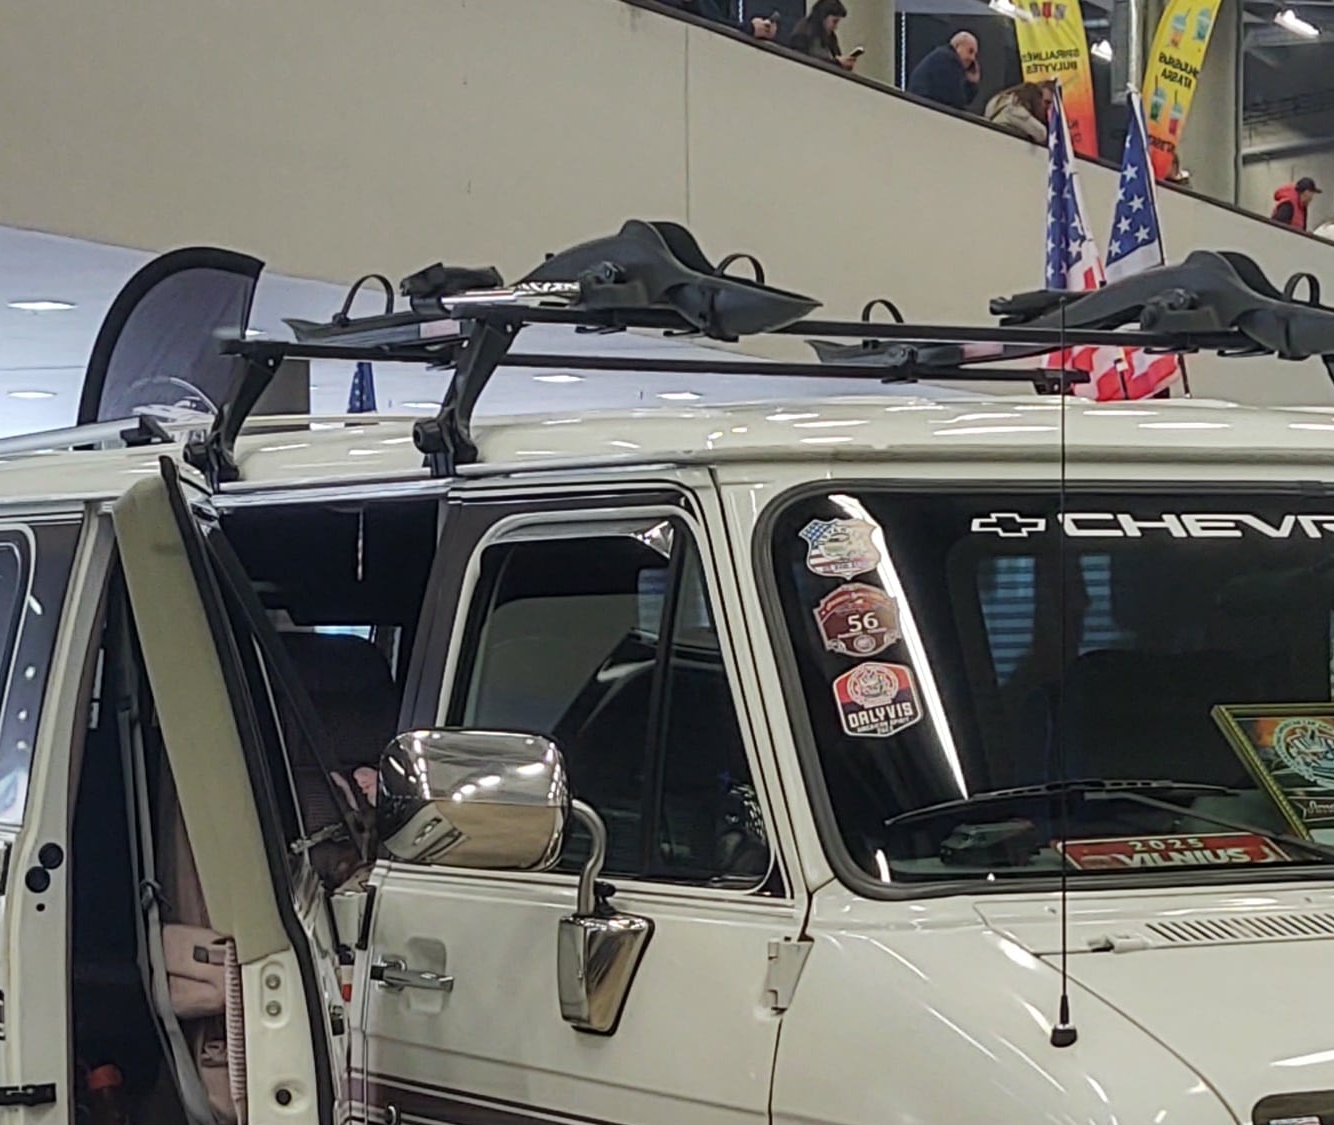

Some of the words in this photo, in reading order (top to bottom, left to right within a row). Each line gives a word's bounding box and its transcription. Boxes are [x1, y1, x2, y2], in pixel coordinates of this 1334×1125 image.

[848, 612, 879, 632] 56
[848, 702, 914, 728] DALYVIS
[1129, 838, 1205, 851] 2025
[1113, 848, 1251, 868] VILNIUS
